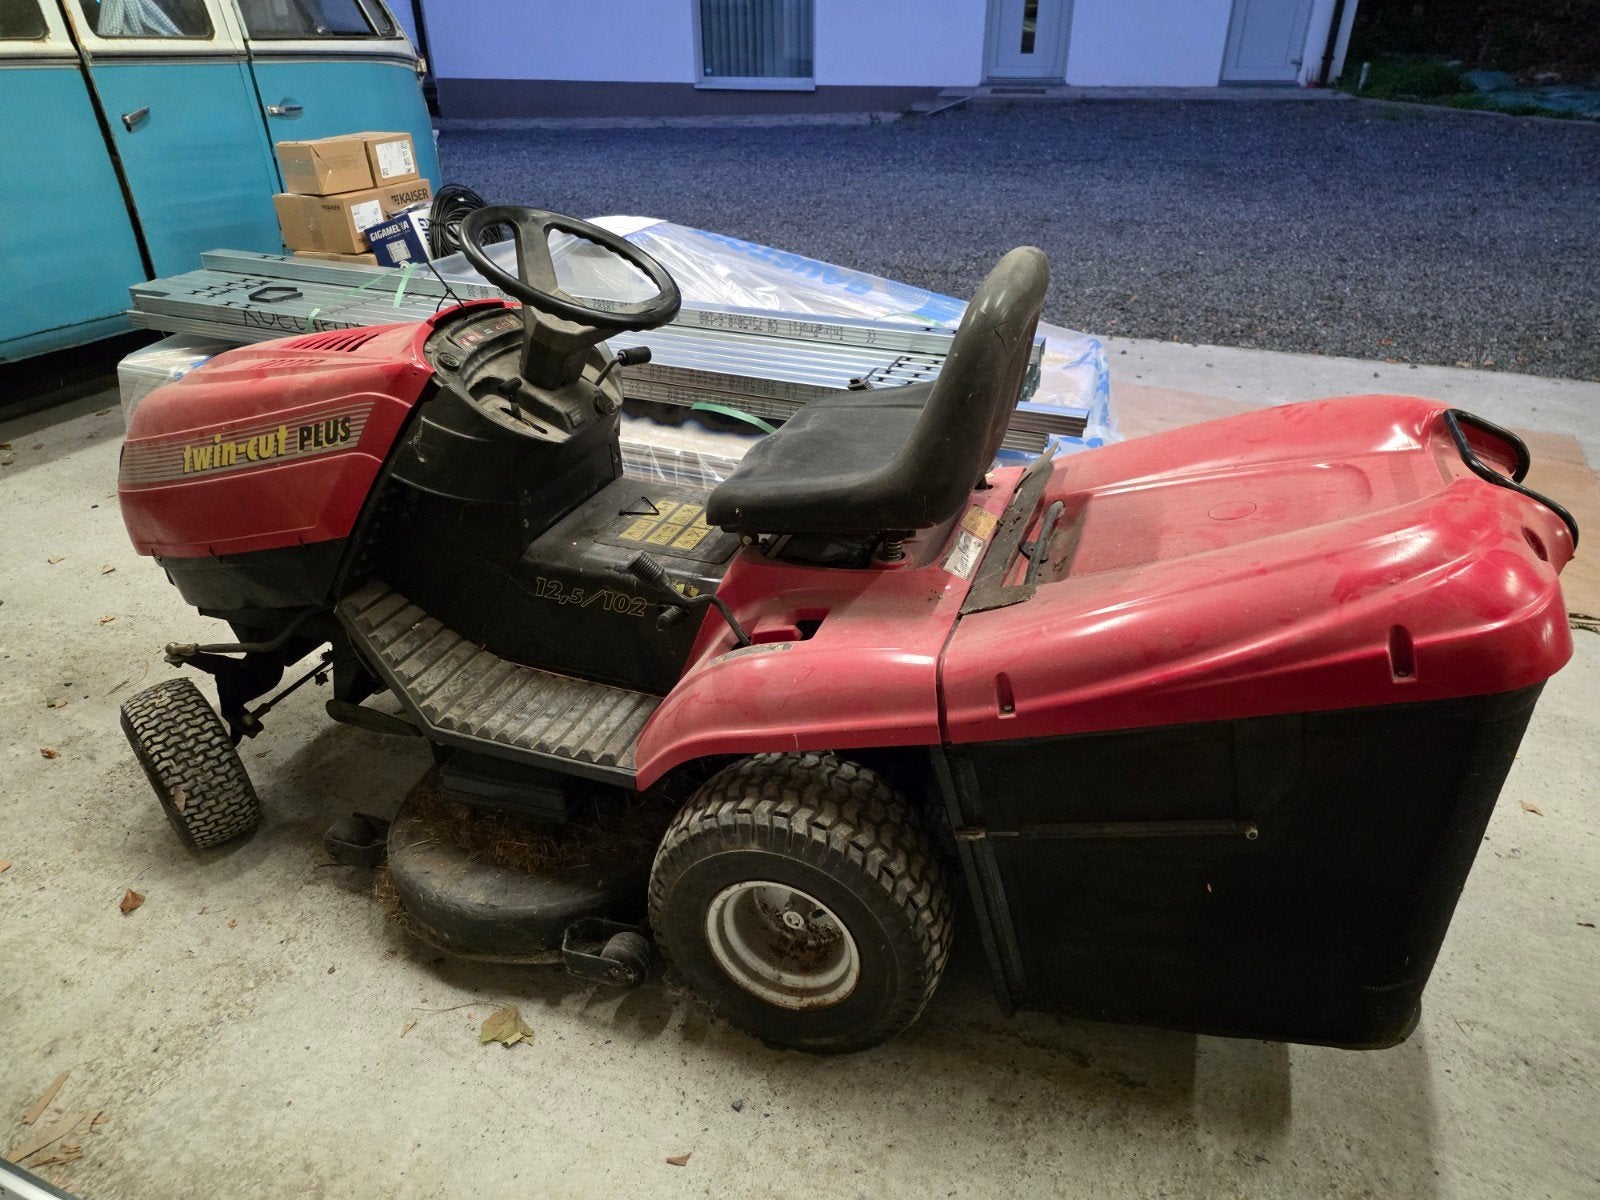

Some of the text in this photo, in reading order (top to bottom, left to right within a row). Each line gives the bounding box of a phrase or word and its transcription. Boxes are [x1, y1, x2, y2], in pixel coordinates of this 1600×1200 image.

[399, 188, 429, 205] KAISER
[183, 416, 352, 474] twin-cut PLUS
[535, 576, 648, 618] 12,5/102
